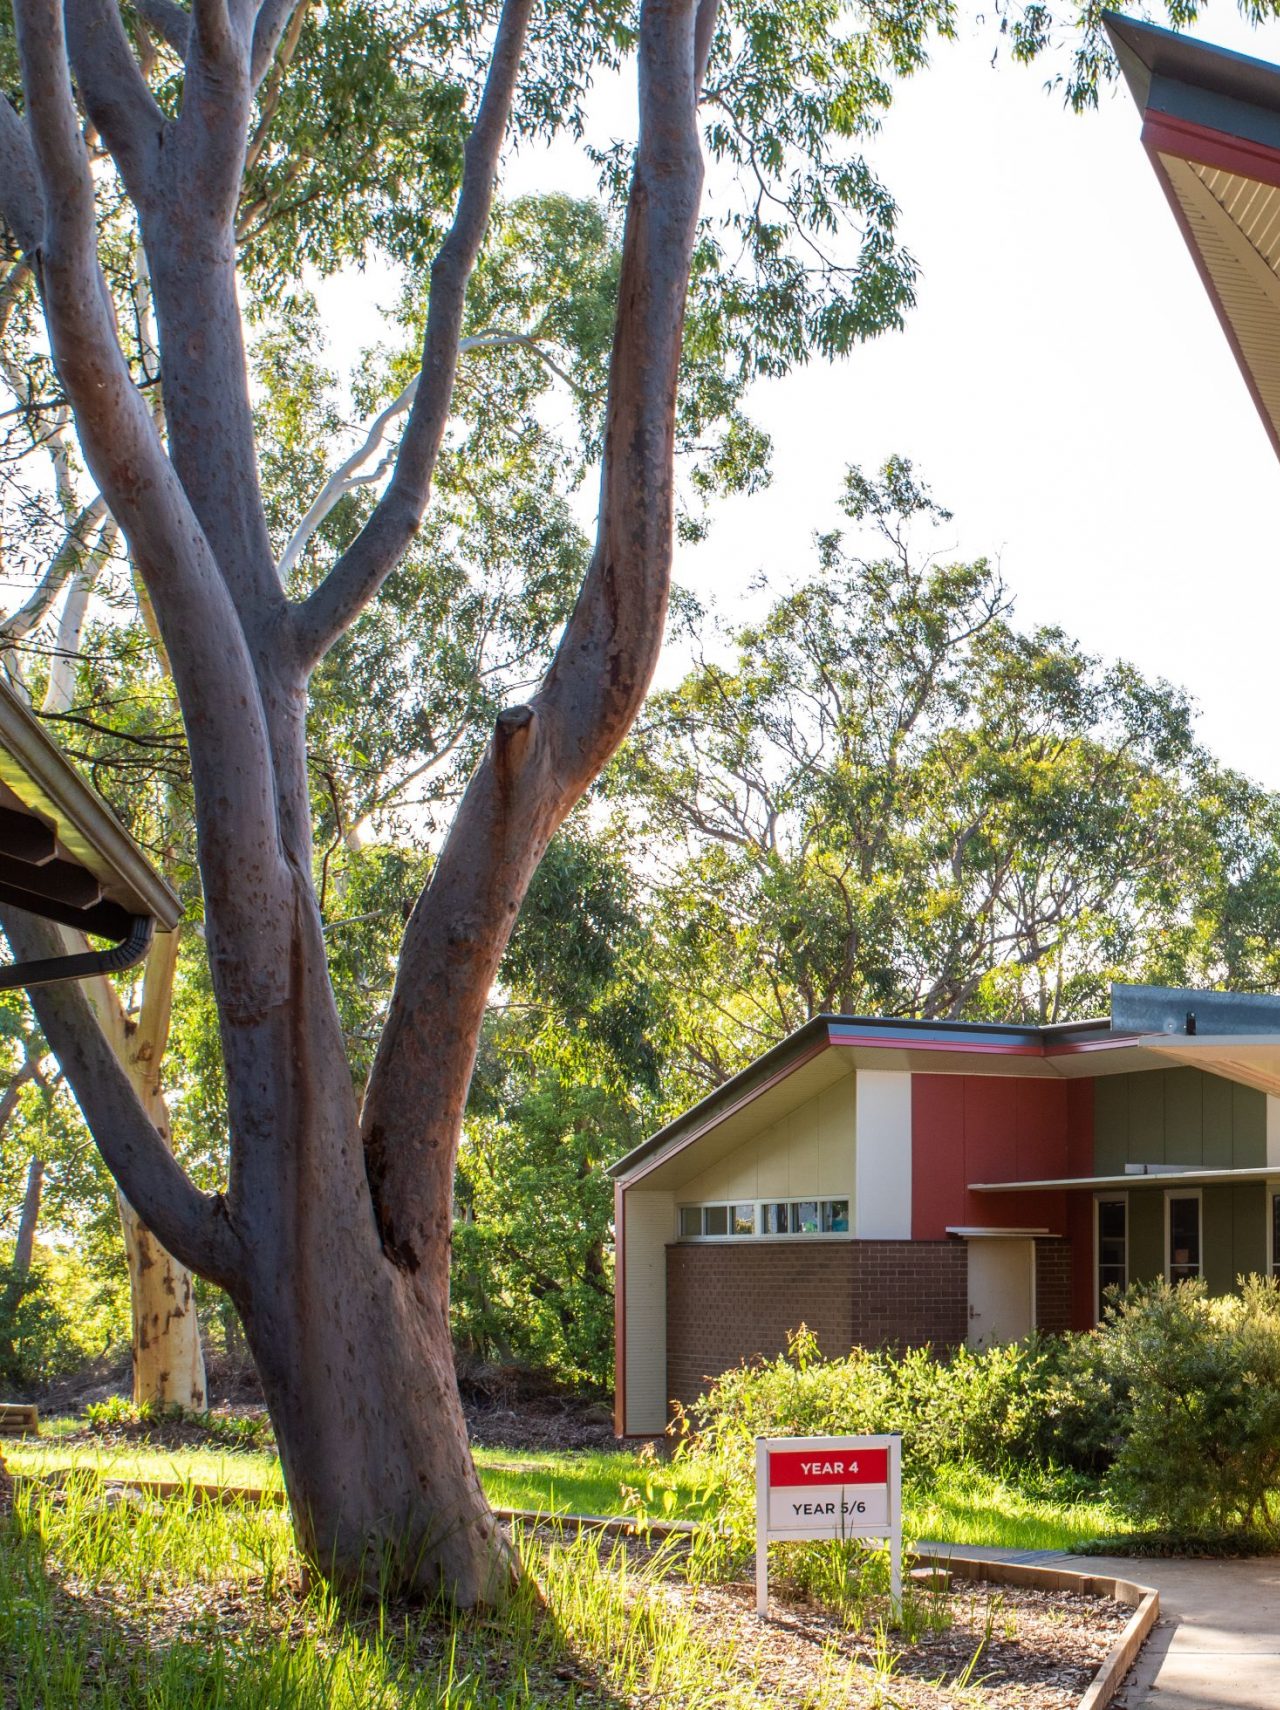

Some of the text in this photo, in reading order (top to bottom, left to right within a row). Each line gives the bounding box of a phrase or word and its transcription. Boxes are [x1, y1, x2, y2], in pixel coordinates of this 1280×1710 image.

[801, 1462, 858, 1475] YEAR 4
[792, 1501, 865, 1515] YEAR 5/6
